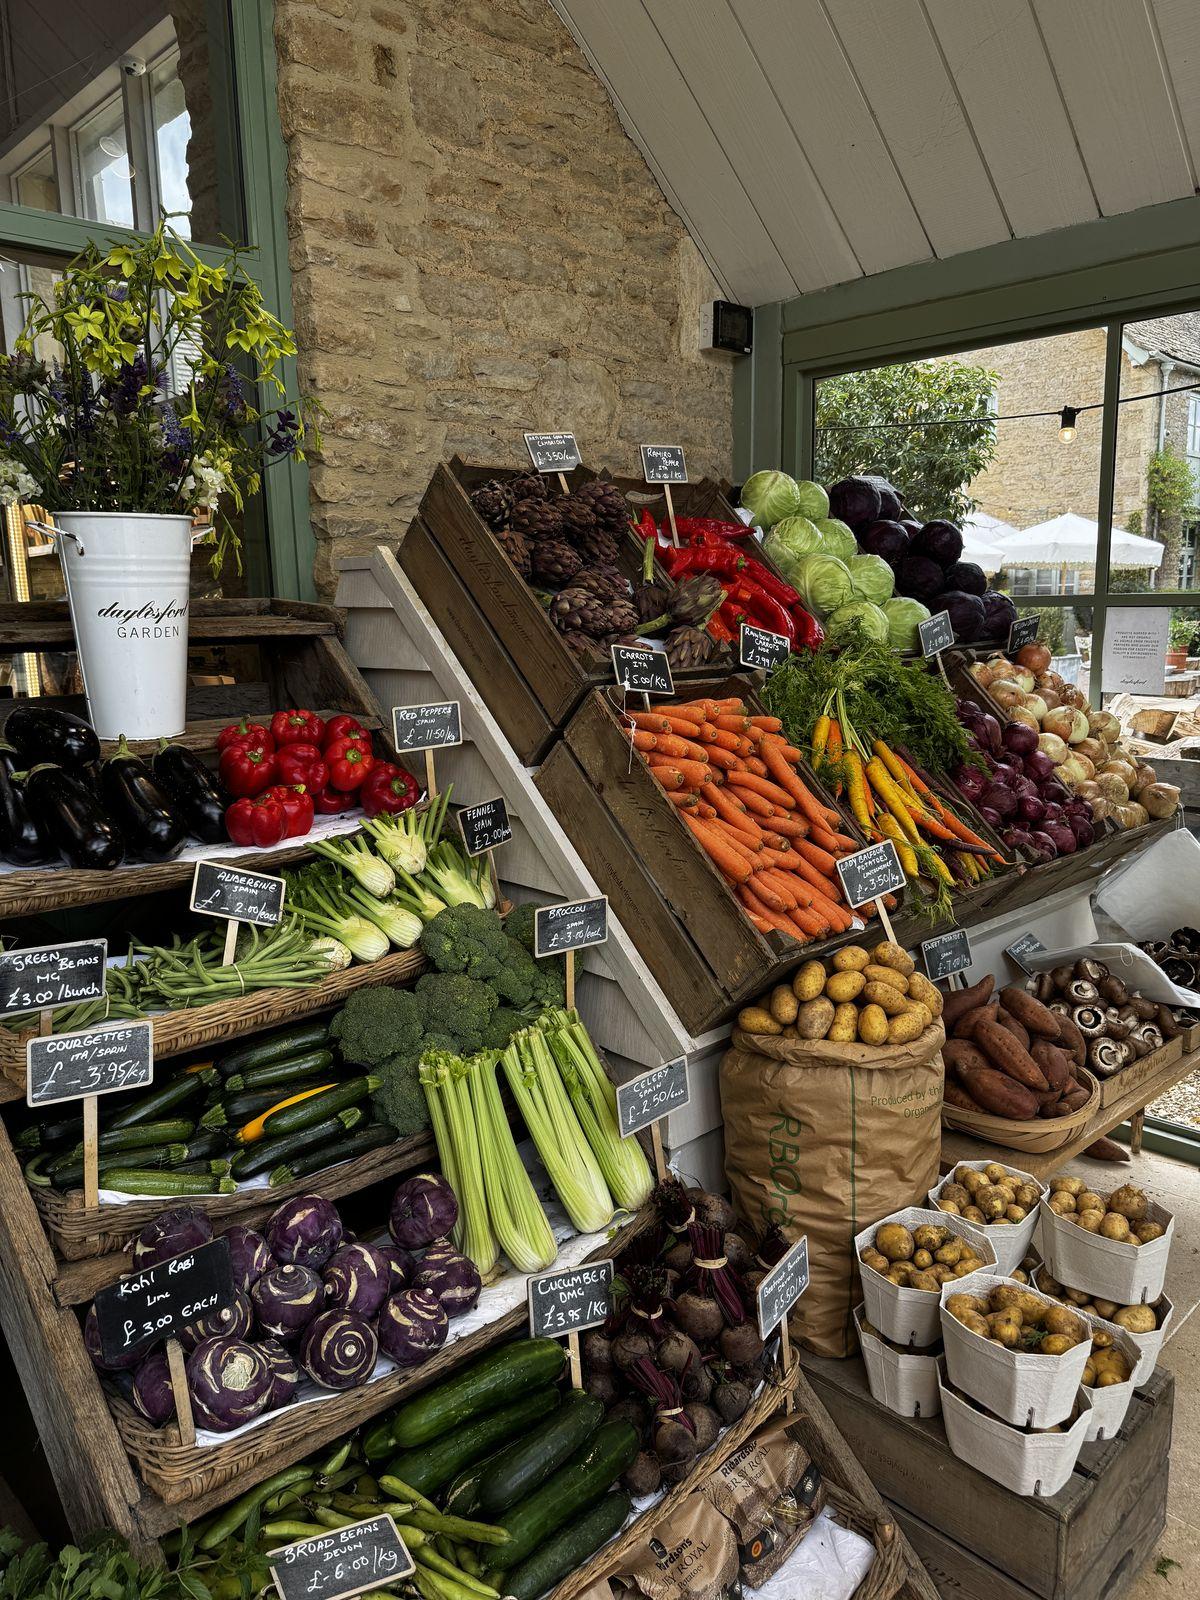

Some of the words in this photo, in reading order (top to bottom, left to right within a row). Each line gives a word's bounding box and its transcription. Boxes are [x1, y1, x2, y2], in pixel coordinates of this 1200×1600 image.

[97, 599, 189, 625] daylesford
[117, 626, 179, 638] GARDEN
[620, 650, 654, 660] CARROTS
[633, 661, 648, 669] ITA
[399, 710, 418, 720] RED
[420, 706, 452, 717] PEPPERS
[415, 718, 436, 726] SPAIN
[466, 804, 496, 821] FENNEL
[474, 818, 492, 832] SPAIN
[840, 858, 857, 872] LADY
[858, 845, 886, 864] BALFOUR
[857, 853, 888, 874] POTATOES
[217, 871, 277, 893] AUBERGINE
[232, 885, 258, 895] SPAIN
[566, 920, 584, 930] SPAIN
[12, 951, 60, 971] GREEN
[57, 956, 99, 971] BEANS
[46, 1030, 133, 1053] COURGETTES
[633, 1067, 669, 1092] CELERY
[638, 1081, 662, 1099] SPAIN
[871, 1091, 913, 1106] Produced
[915, 1088, 926, 1100] by
[538, 1269, 606, 1295] CUCUMBER
[181, 1293, 218, 1317] EACH
[284, 1538, 335, 1564] BROAD
[340, 1522, 379, 1543] BEANS
[323, 1541, 363, 1562] DEVON
[677, 1541, 711, 1574] ROYAL
